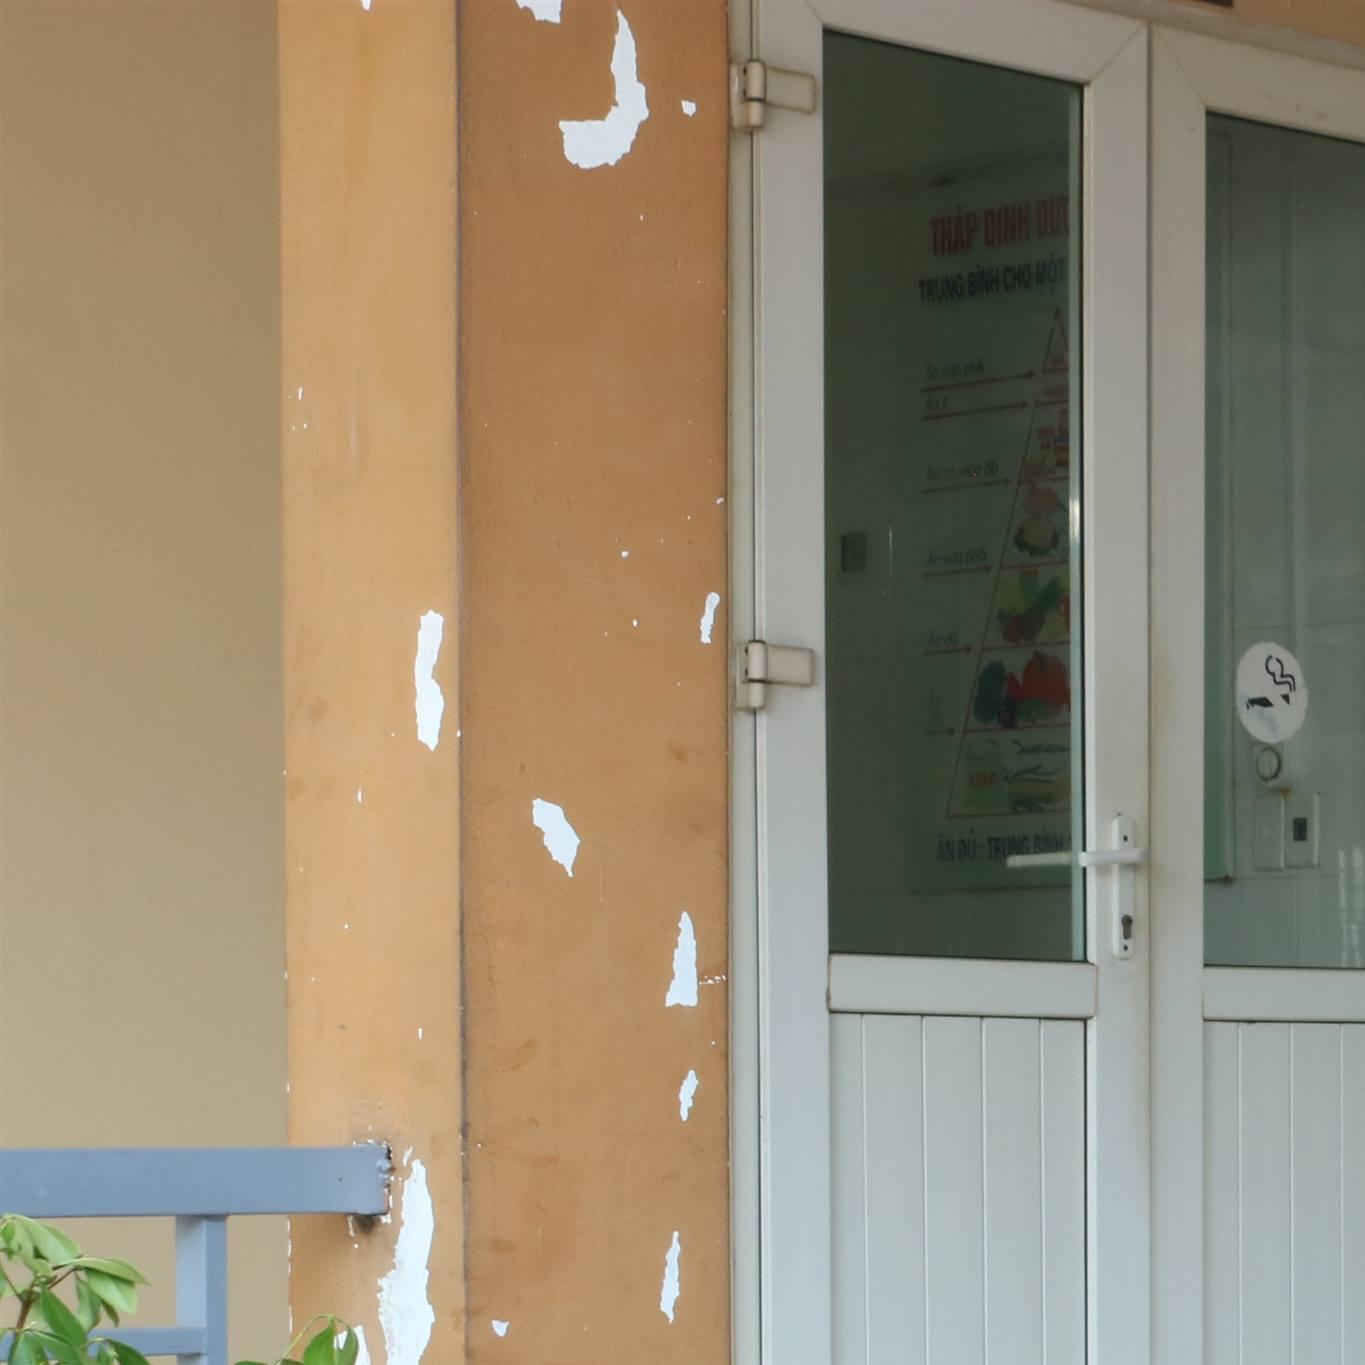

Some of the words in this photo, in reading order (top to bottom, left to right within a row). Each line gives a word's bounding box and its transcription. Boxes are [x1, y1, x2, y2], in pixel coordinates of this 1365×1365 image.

[928, 204, 977, 256] THÁP
[919, 274, 964, 303] TRUNG
[967, 264, 999, 296] BÌNH
[1003, 263, 1031, 290] CHO
